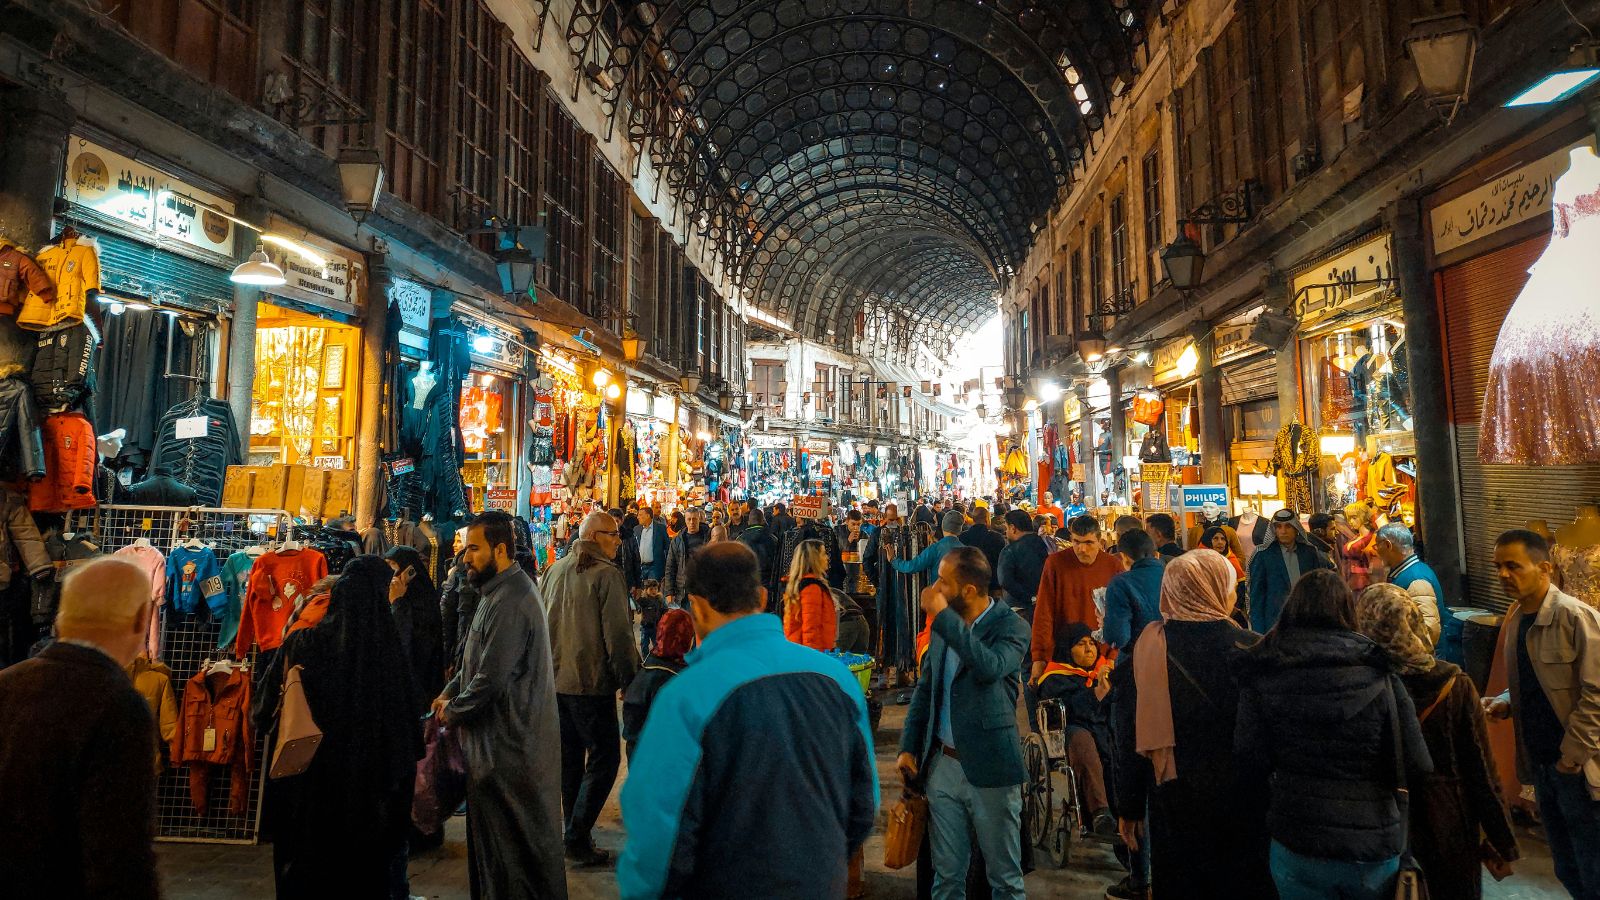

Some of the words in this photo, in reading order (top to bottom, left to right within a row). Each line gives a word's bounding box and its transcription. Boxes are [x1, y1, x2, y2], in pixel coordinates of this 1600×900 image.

[116, 206, 147, 221] كيون
[488, 490, 508, 499] بلاش
[1185, 493, 1226, 502] PHILIPS
[487, 501, 512, 509] 36000
[794, 508, 817, 517] 32000
[207, 576, 222, 593] 19
